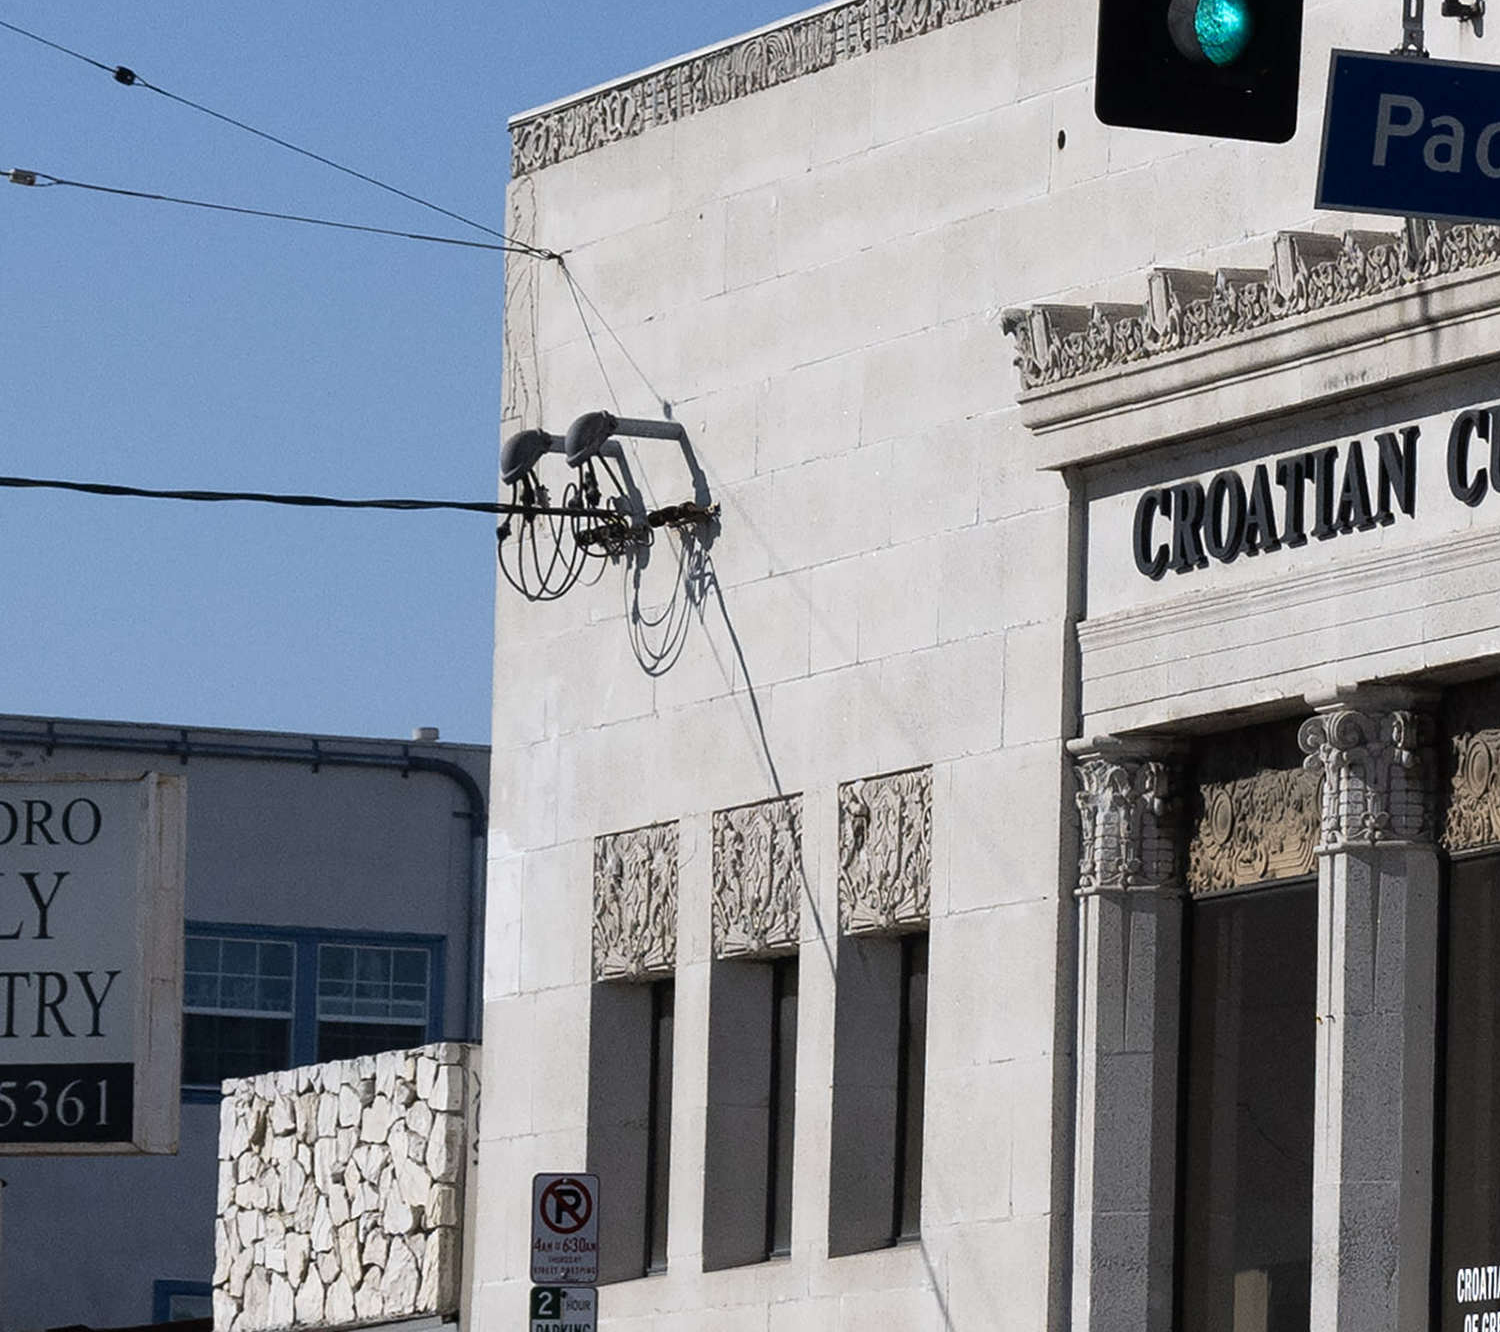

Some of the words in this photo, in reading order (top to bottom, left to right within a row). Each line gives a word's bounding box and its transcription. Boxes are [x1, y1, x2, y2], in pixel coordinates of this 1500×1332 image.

[1132, 424, 1420, 581] CROATIAN
[0, 970, 122, 1038] TRY
[0, 1078, 110, 1127] 5361
[537, 1290, 554, 1316] 2
[566, 1298, 592, 1312] HOUR
